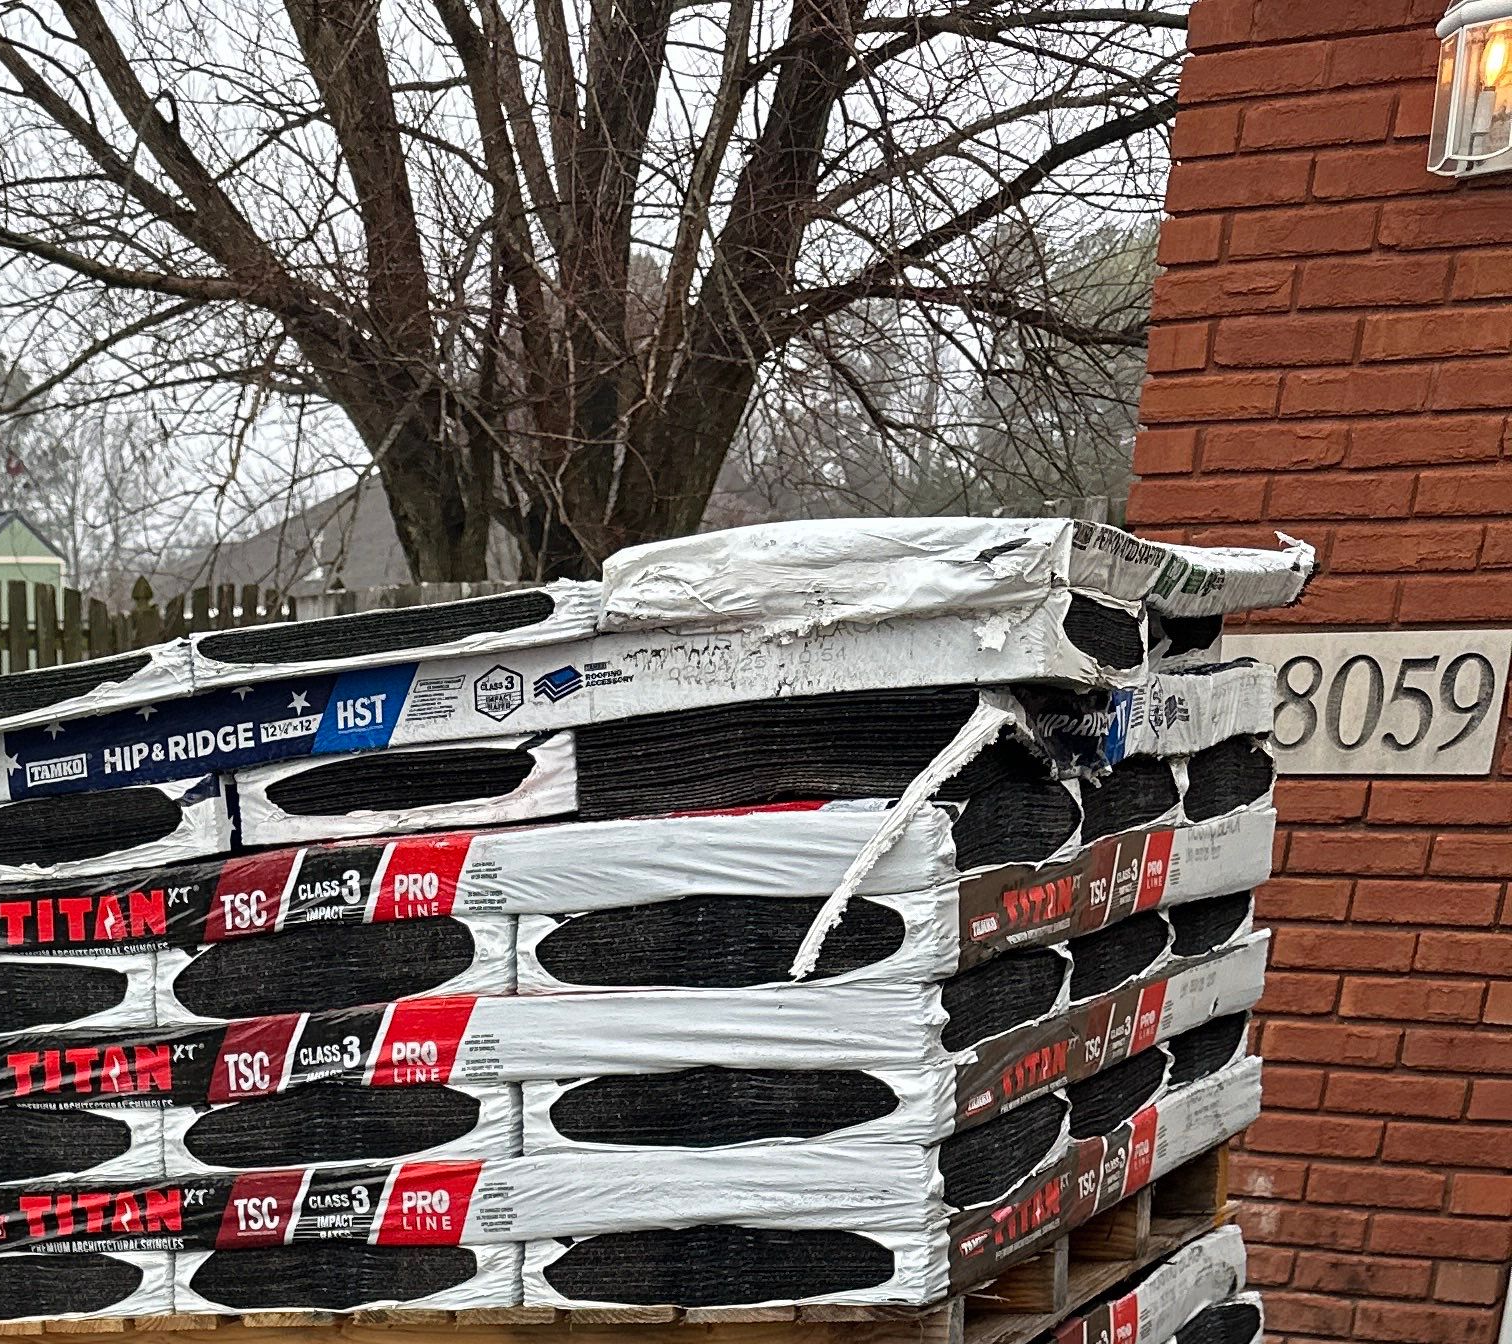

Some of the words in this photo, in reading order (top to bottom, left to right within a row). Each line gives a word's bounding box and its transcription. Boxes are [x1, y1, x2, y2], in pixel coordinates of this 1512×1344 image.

[505, 676, 514, 691] 3
[337, 694, 386, 729] HST
[1275, 652, 1496, 752] 8059
[30, 762, 82, 781] TAMKO
[1131, 858, 1138, 880] 3
[1147, 861, 1163, 877] PRO
[298, 881, 339, 899] CLASS
[342, 870, 360, 904] 3
[395, 873, 438, 901] PRO
[1089, 878, 1106, 906] TSC
[220, 890, 267, 930] TSC
[306, 906, 343, 921] IMPACT
[395, 902, 438, 918] LINE
[1003, 876, 1073, 927] TITAN
[300, 1045, 340, 1065] CLASS
[343, 1036, 360, 1068] 3
[392, 1041, 438, 1066] PRO
[1085, 1036, 1101, 1063] TSC
[7, 1045, 172, 1096] TITAN
[225, 1052, 270, 1092] TSC
[394, 1068, 439, 1082] LINE
[1001, 1040, 1068, 1096] TITAN
[1078, 1170, 1095, 1200] TSC
[19, 1189, 182, 1238] TITAN
[235, 1197, 280, 1231] TSC
[309, 1196, 350, 1209] CLASS
[352, 1186, 370, 1214] 3
[403, 1191, 449, 1214] PRO
[317, 1216, 353, 1228] IMPACT
[403, 1217, 452, 1231] LINE
[72, 1240, 138, 1252] ARCHITECTURAL
[140, 1238, 184, 1250] SHINGLES
[1116, 1322, 1133, 1342] PRO
